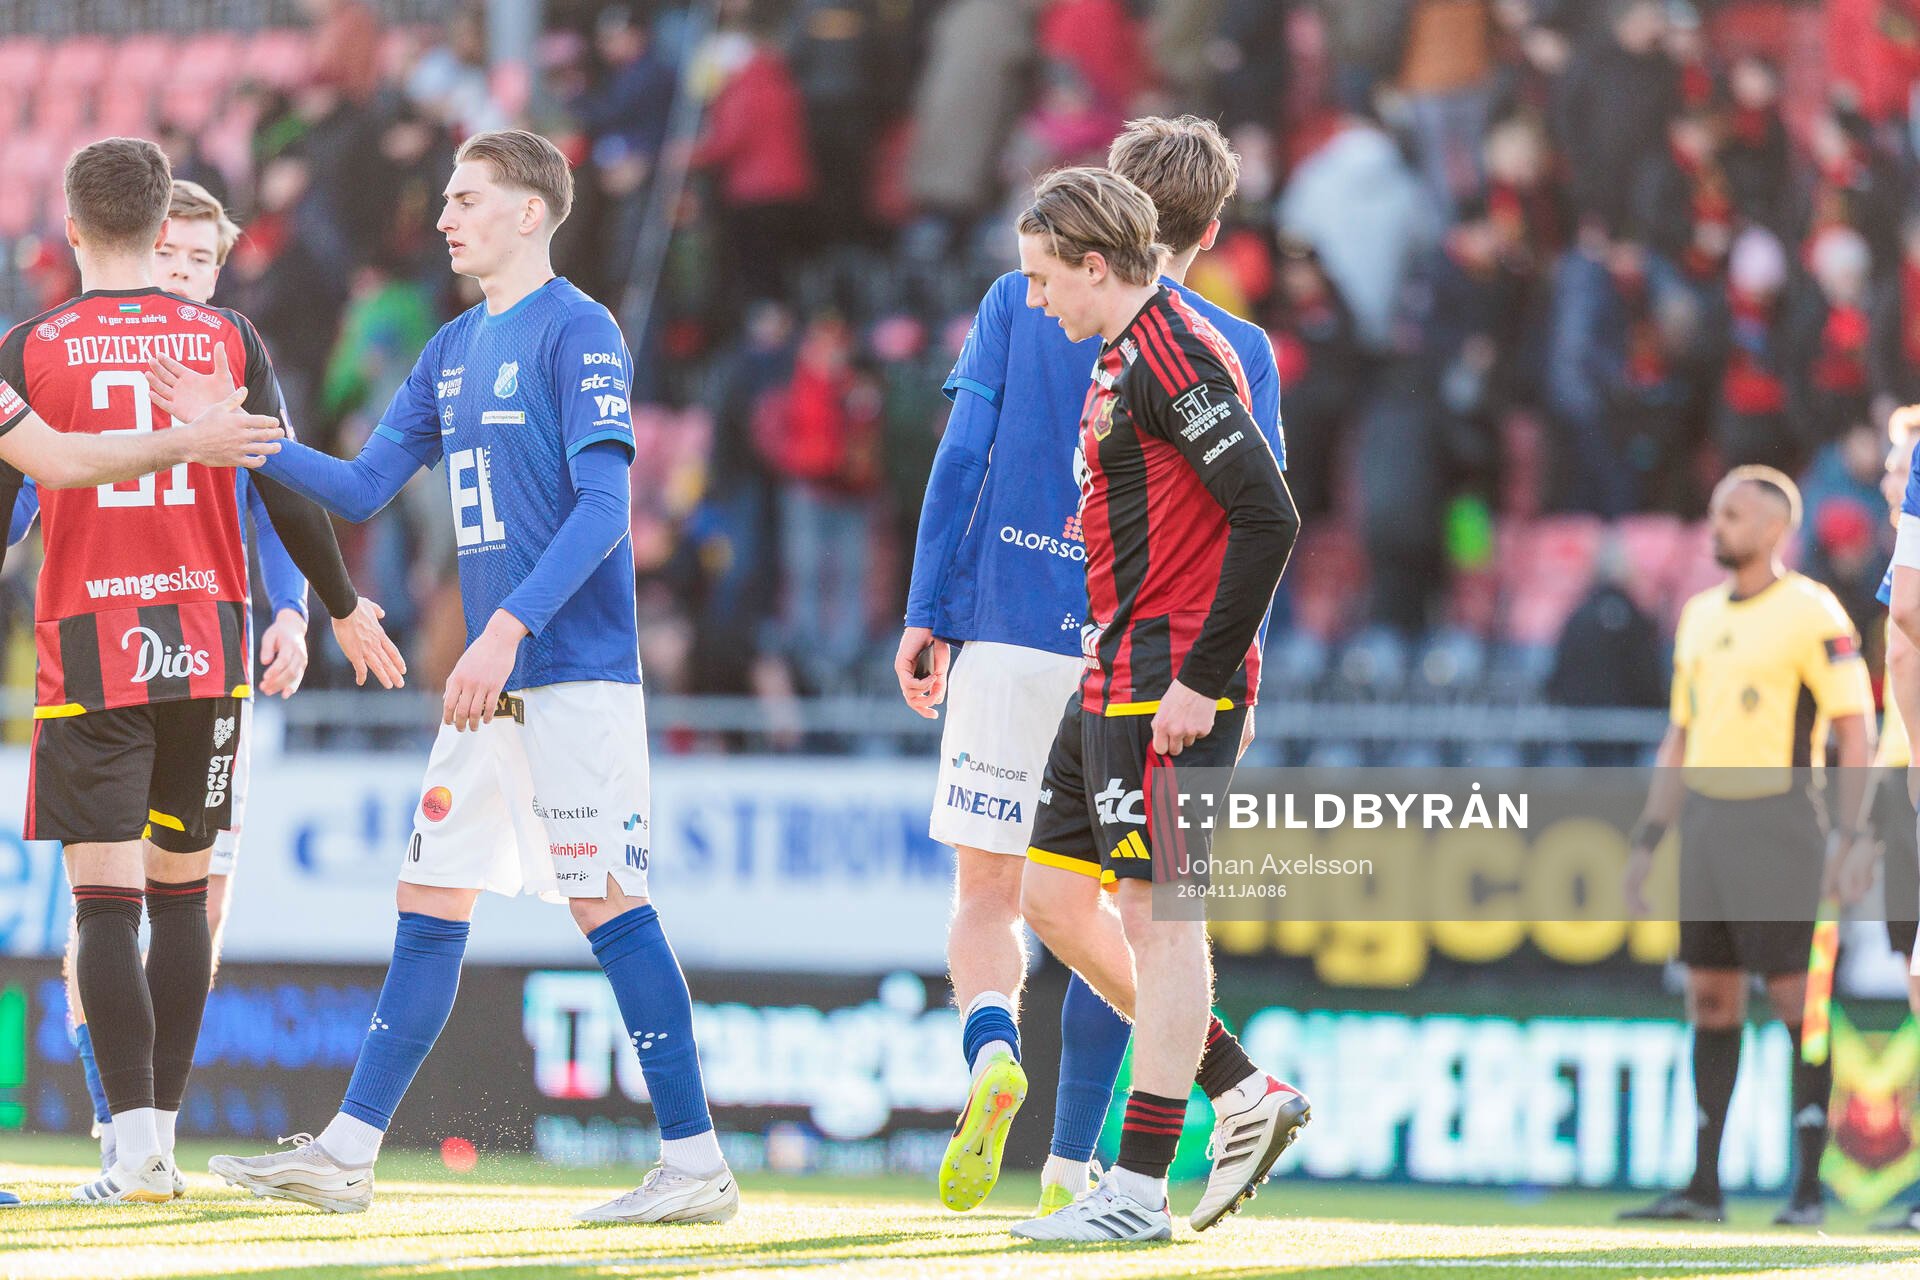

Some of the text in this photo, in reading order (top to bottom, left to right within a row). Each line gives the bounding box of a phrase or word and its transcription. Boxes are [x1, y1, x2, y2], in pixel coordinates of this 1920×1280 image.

[97, 315, 107, 324] Vi
[109, 317, 123, 326] ger
[142, 314, 167, 324] aldrig
[64, 333, 211, 366] BOZICKOVIC
[581, 374, 611, 392] stc
[593, 394, 627, 418] YP
[1180, 401, 1229, 437] THORGERZON
[1187, 409, 1232, 442] REKLAM AB
[1202, 430, 1244, 465] stadium
[450, 447, 505, 547] EL
[86, 566, 219, 600] wangeskog
[121, 626, 210, 682] Diös
[551, 806, 598, 819] Textile
[947, 784, 1022, 823] INSECTA
[625, 844, 648, 871] INS
[556, 872, 578, 880] RAFT
